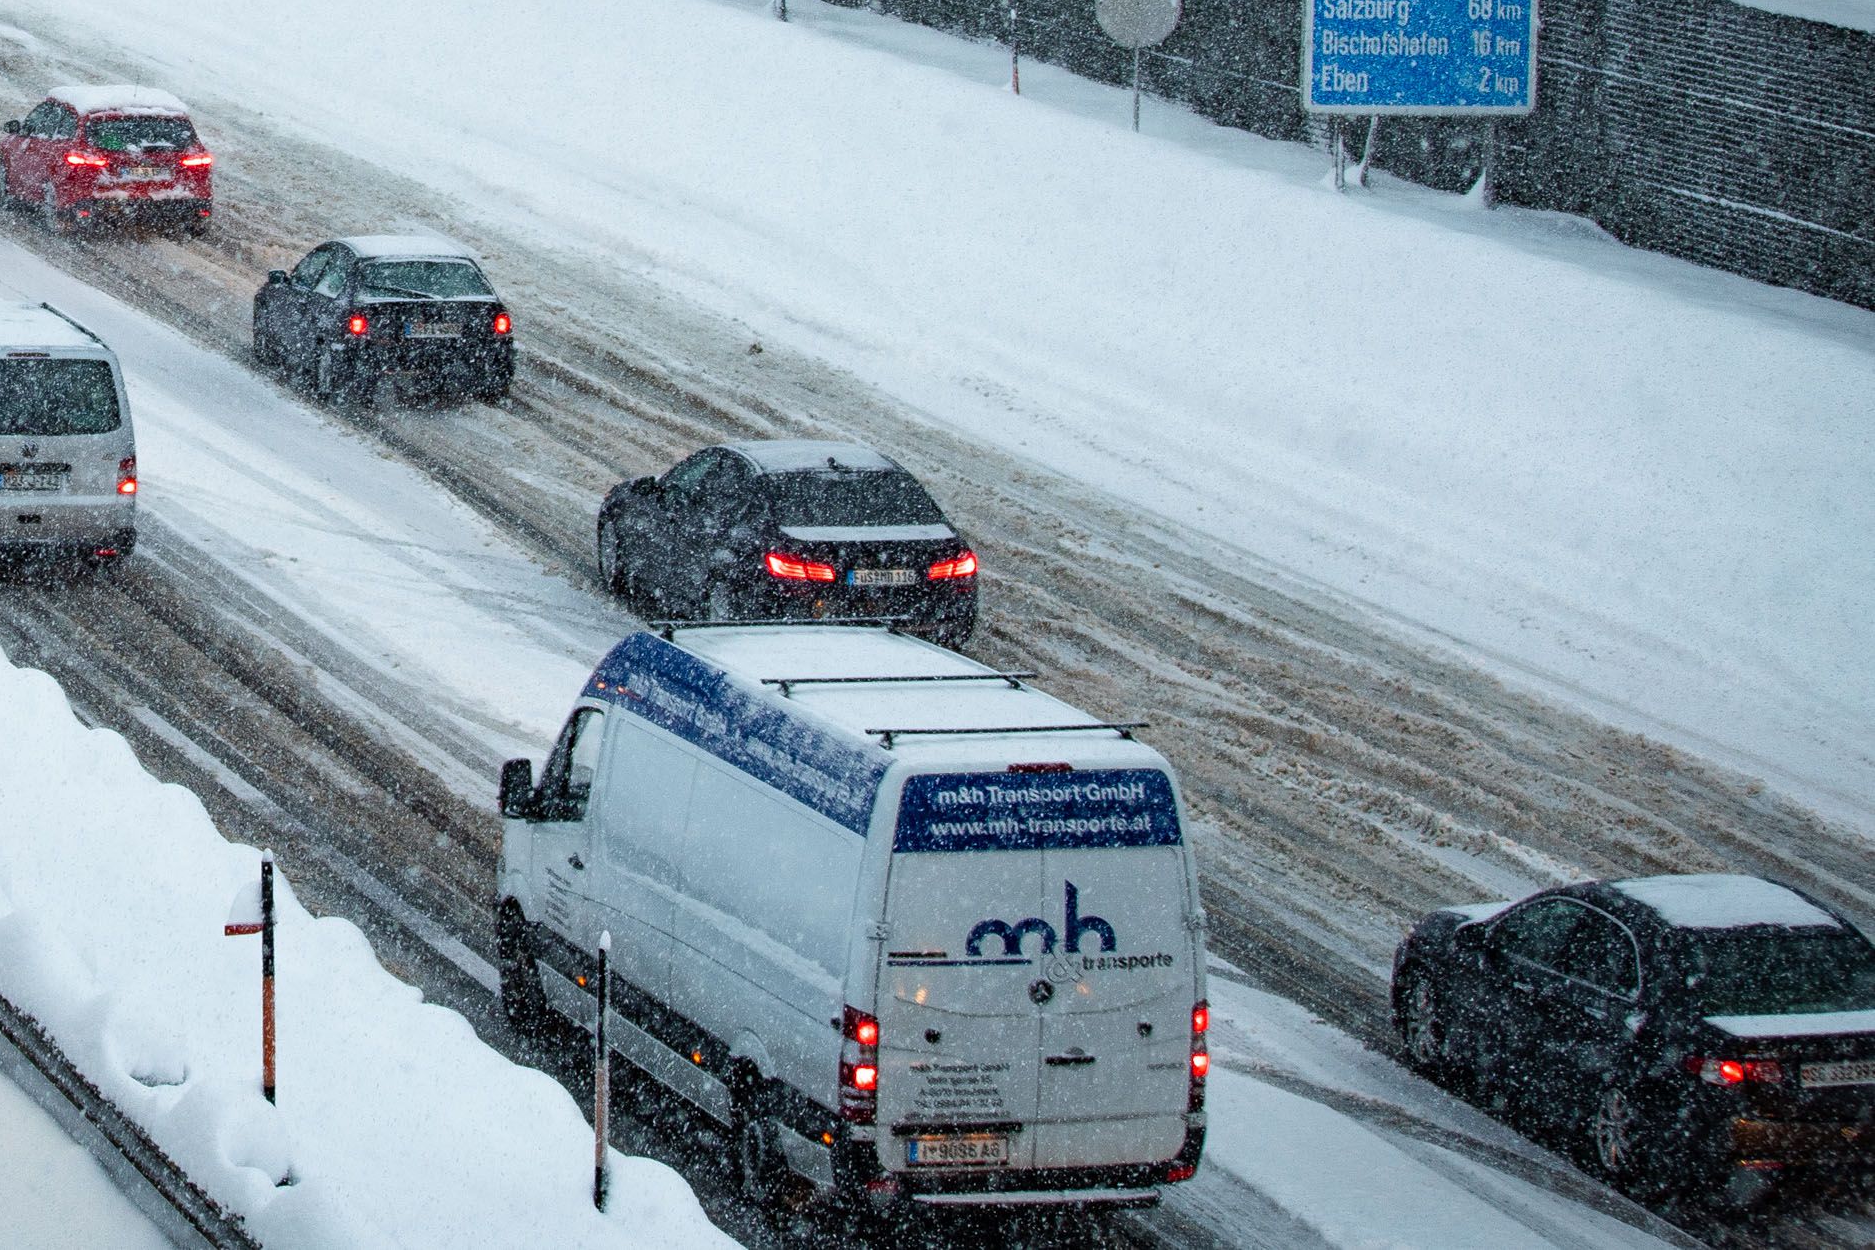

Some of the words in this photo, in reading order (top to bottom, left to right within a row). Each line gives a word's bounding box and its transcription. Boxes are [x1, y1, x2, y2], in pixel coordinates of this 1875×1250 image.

[1497, 1, 1522, 20] km
[1322, 30, 1450, 56] Bischofshofen
[1473, 30, 1492, 55] 16
[1496, 36, 1521, 56] km
[1321, 64, 1368, 93] Eben
[1478, 67, 1492, 93] 2
[1495, 72, 1519, 93] km
[938, 786, 984, 804] m&h
[986, 783, 1081, 804] Transport
[1085, 782, 1145, 801] GmbH
[931, 813, 1151, 837] www.mh-transporte.at
[1082, 952, 1174, 971] transporte
